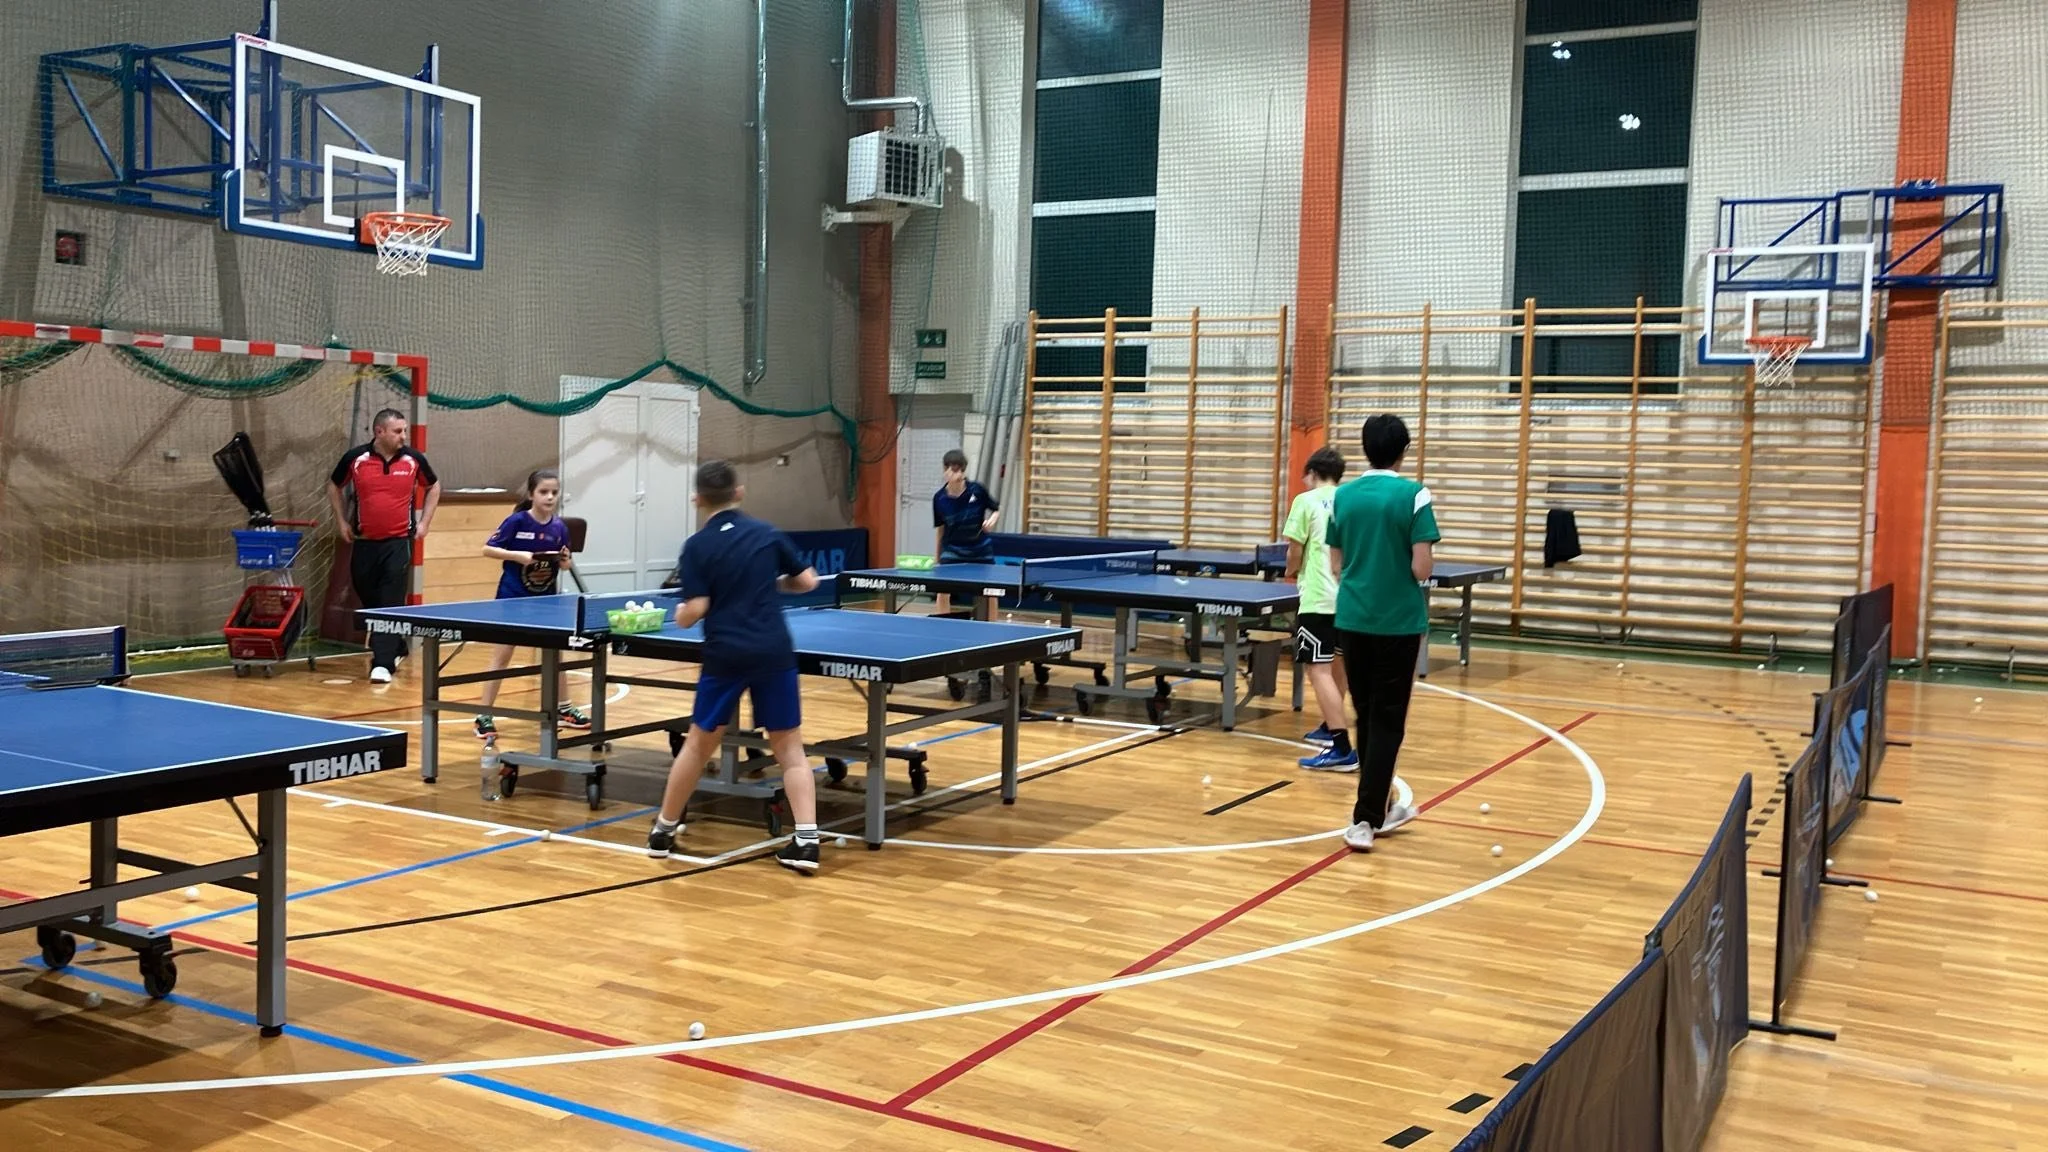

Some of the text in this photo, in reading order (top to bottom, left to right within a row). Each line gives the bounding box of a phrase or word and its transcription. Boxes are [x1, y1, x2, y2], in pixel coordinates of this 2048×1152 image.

[796, 548, 845, 575] HAR
[850, 577, 887, 589] TIBHAR
[1195, 602, 1243, 616] TIBHAR
[365, 619, 412, 635] TIBHAR
[819, 661, 882, 681] TIBHAR
[288, 750, 381, 785] TIBHAR
